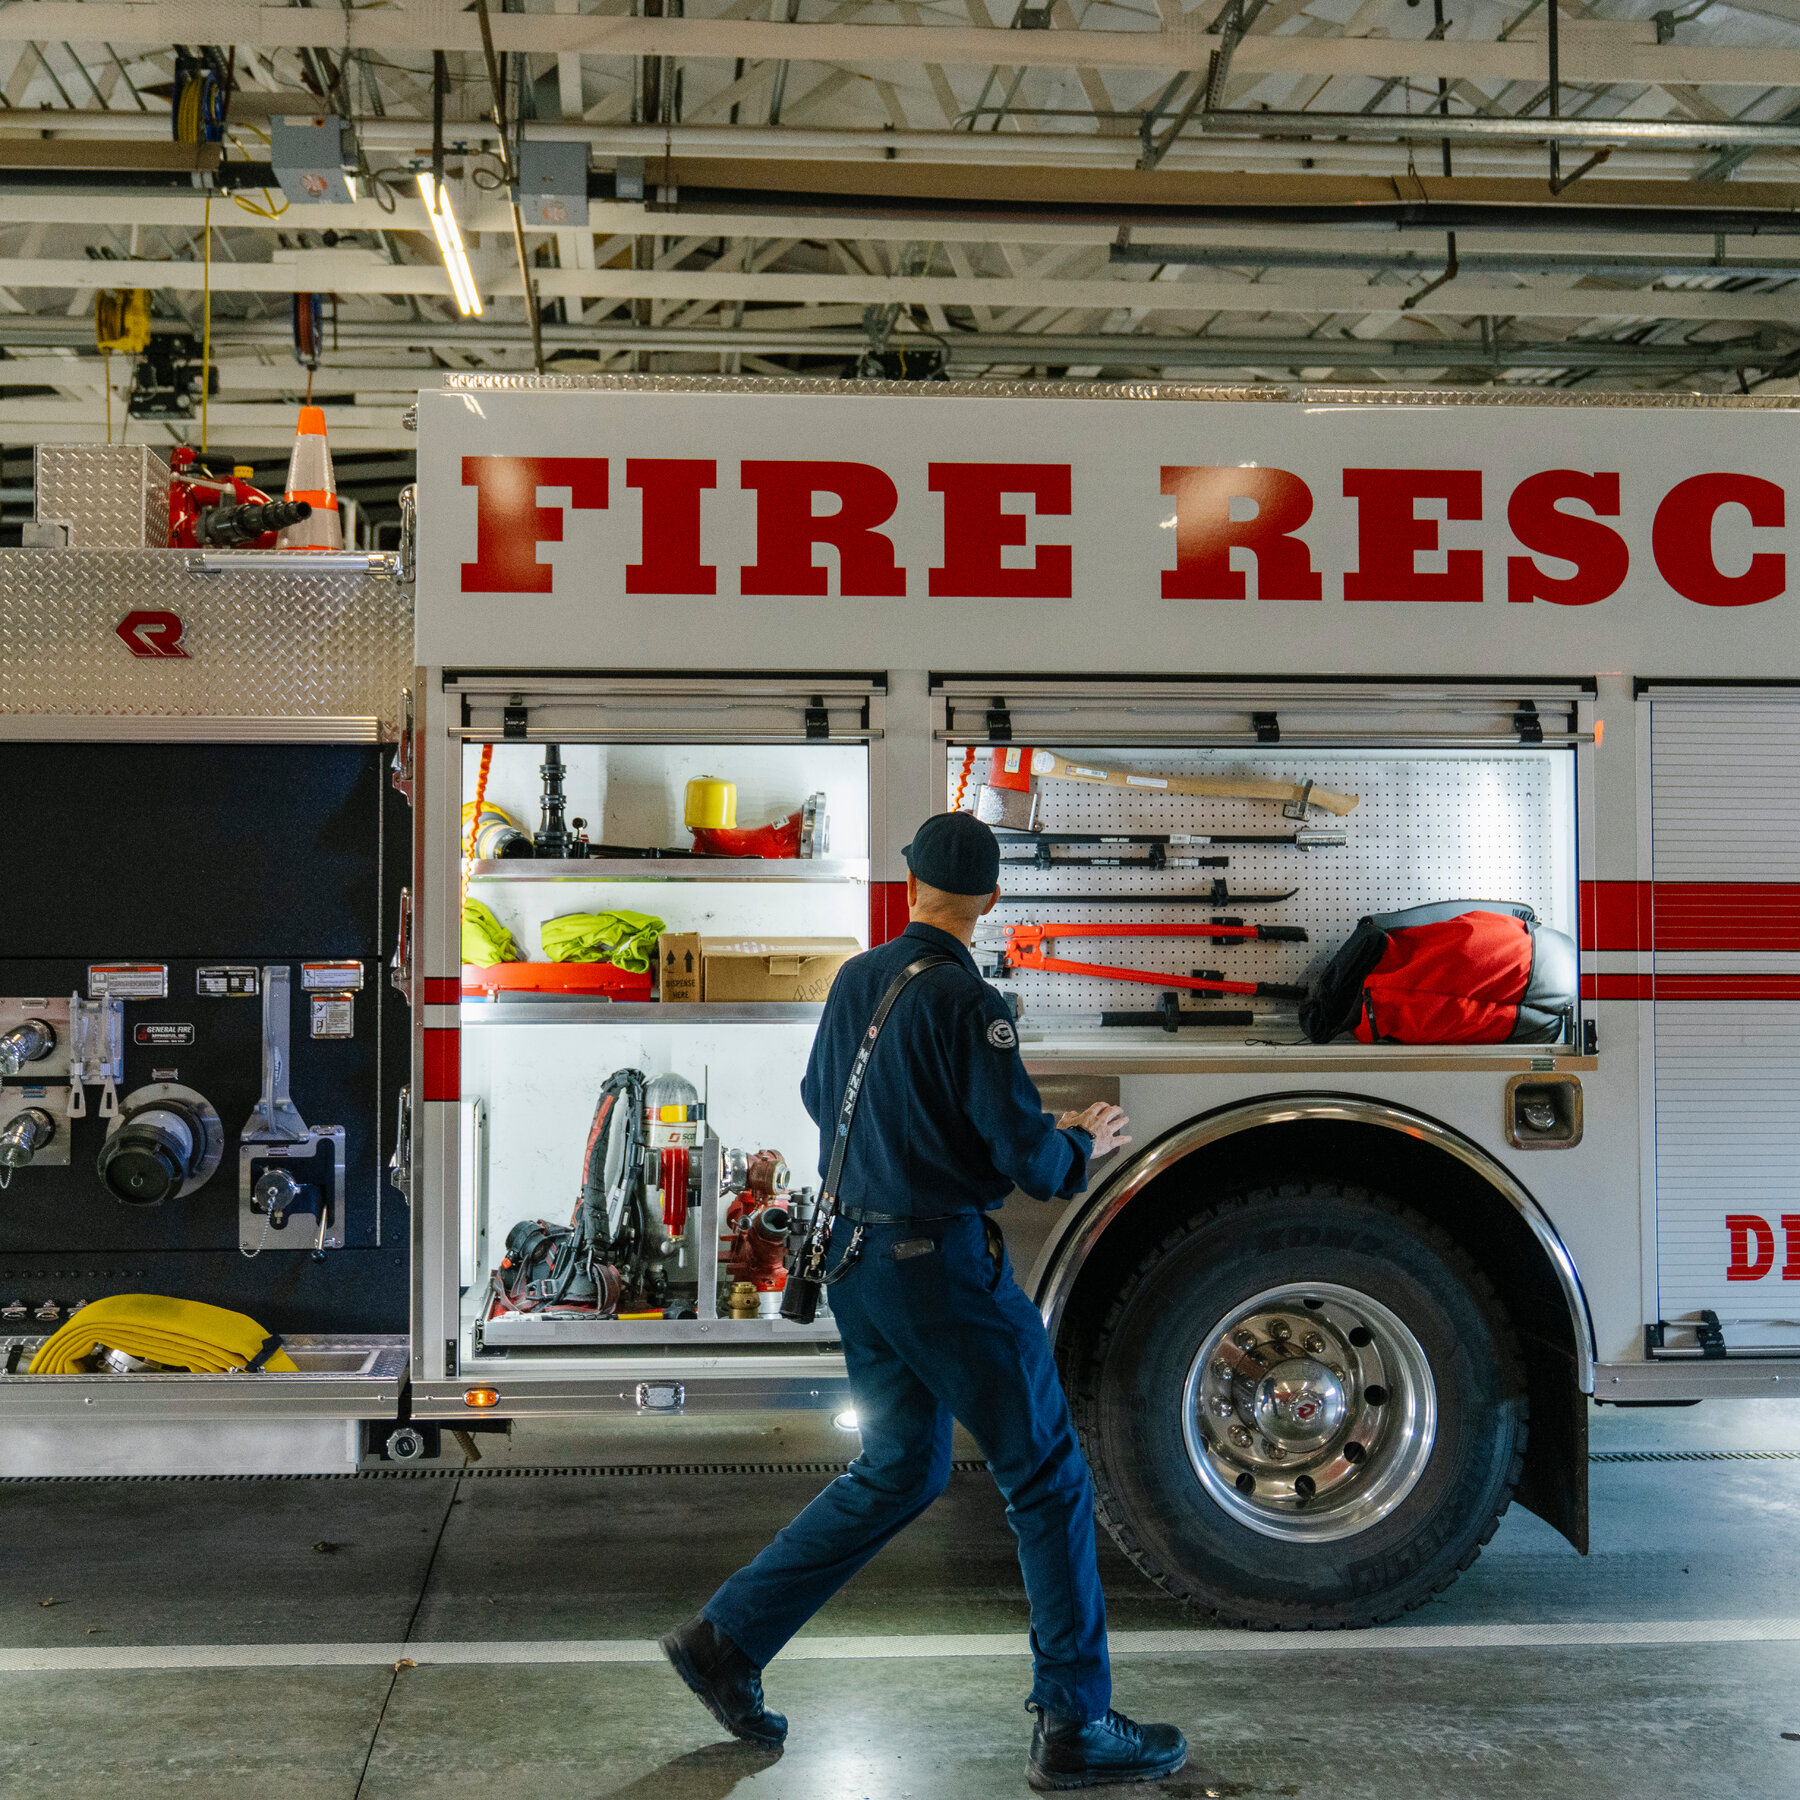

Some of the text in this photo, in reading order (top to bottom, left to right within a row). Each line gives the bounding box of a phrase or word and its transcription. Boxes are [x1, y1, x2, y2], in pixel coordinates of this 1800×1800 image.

[461, 456, 1786, 607] FIRE RESC
[665, 979, 696, 987] DISPENSE
[672, 991, 689, 999] HERE
